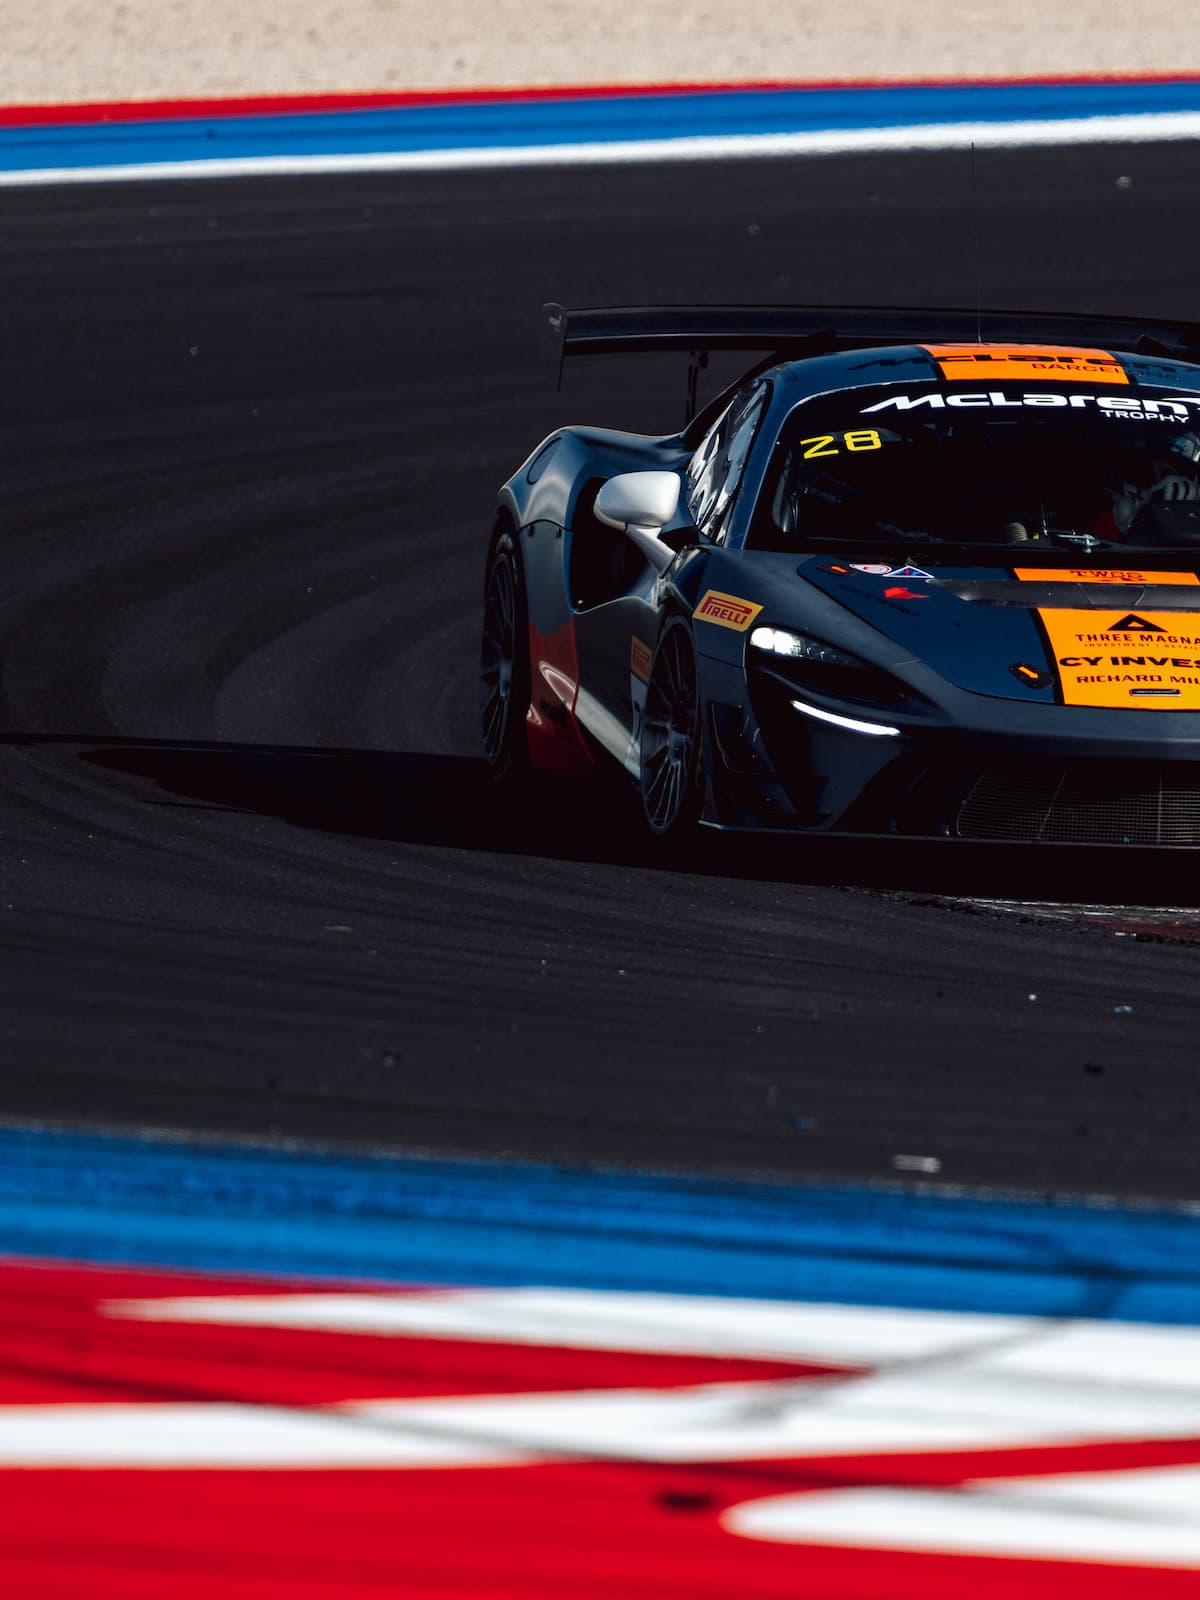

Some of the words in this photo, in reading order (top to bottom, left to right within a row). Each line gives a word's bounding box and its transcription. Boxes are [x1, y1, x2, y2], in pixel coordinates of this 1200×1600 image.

[859, 392, 1192, 415] McLaren
[1100, 410, 1190, 423] TROPHY
[800, 430, 882, 459] 28
[700, 596, 753, 625] PIRELLI
[1075, 633, 1133, 642] THREE
[1059, 656, 1104, 667] CY
[1076, 674, 1162, 684] RICHARD
